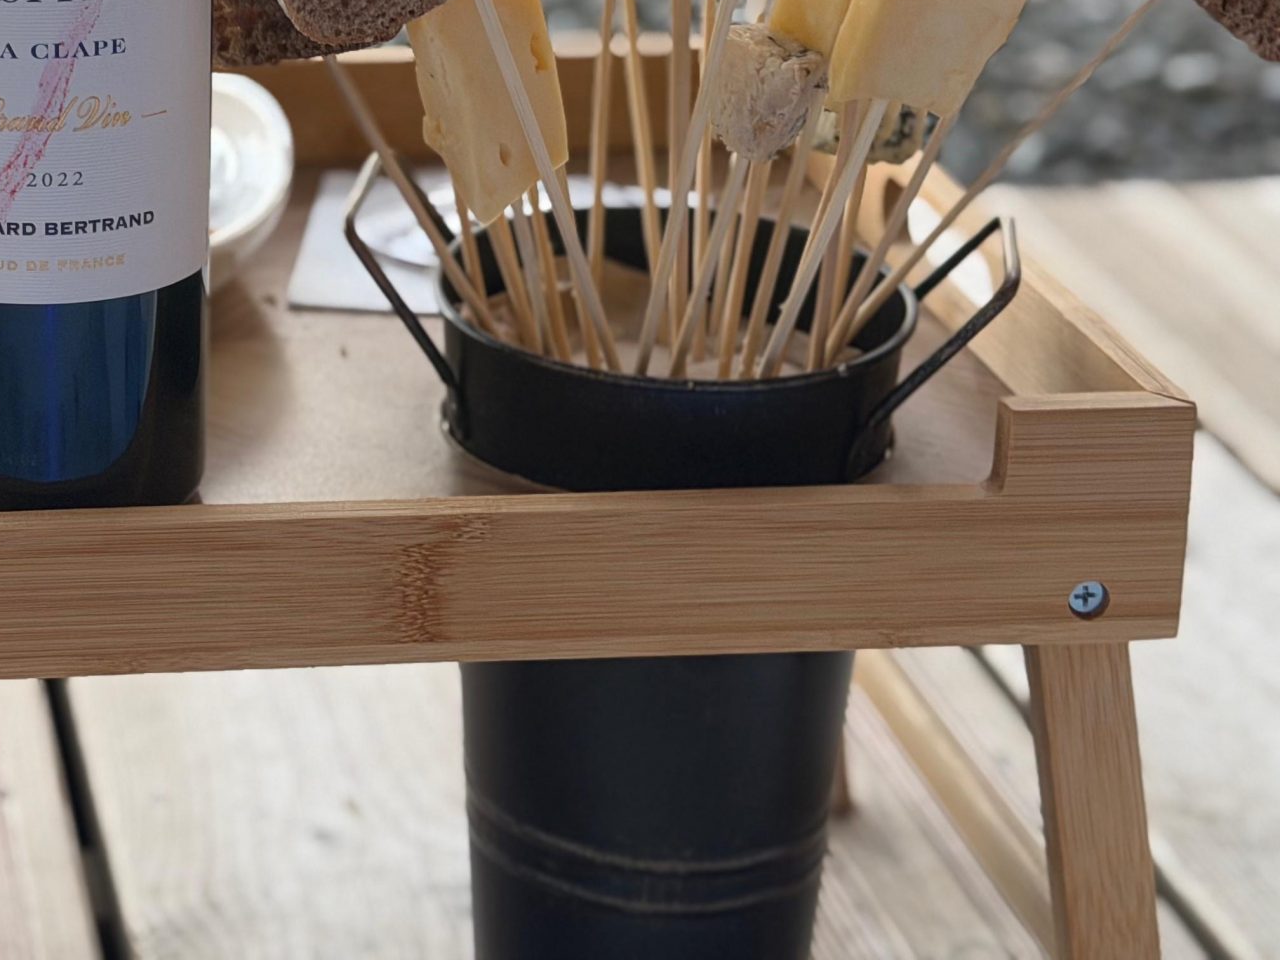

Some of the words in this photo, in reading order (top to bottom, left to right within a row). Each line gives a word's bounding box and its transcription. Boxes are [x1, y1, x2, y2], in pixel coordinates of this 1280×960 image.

[30, 37, 128, 61] CLAPE
[71, 96, 132, 133] Vin
[25, 170, 85, 189] 2022
[44, 209, 156, 237] BERTRAND
[26, 258, 51, 272] DE
[56, 253, 127, 272] FRANCE
